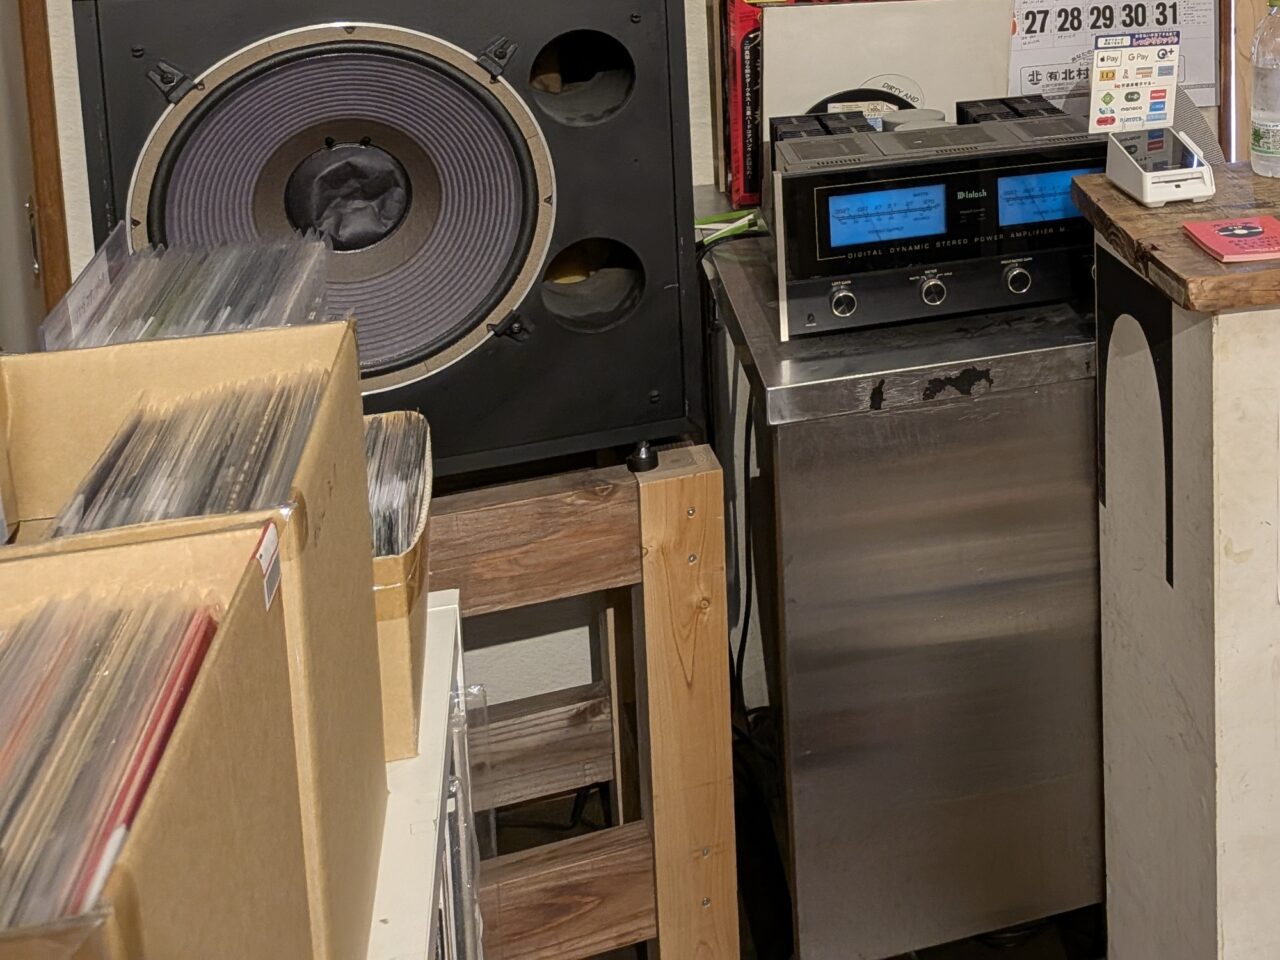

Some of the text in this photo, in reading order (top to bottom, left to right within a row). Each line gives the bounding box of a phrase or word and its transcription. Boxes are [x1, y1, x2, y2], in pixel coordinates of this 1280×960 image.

[1024, 1, 1178, 35] 27 28 29 30 31
[1106, 55, 1119, 63] Pay
[1137, 53, 1149, 61] Pay
[882, 82, 919, 103] DIRTY AND
[848, 227, 1053, 259] DIGITAL DYNAMIC STEREO POWER AMPLIFIER
